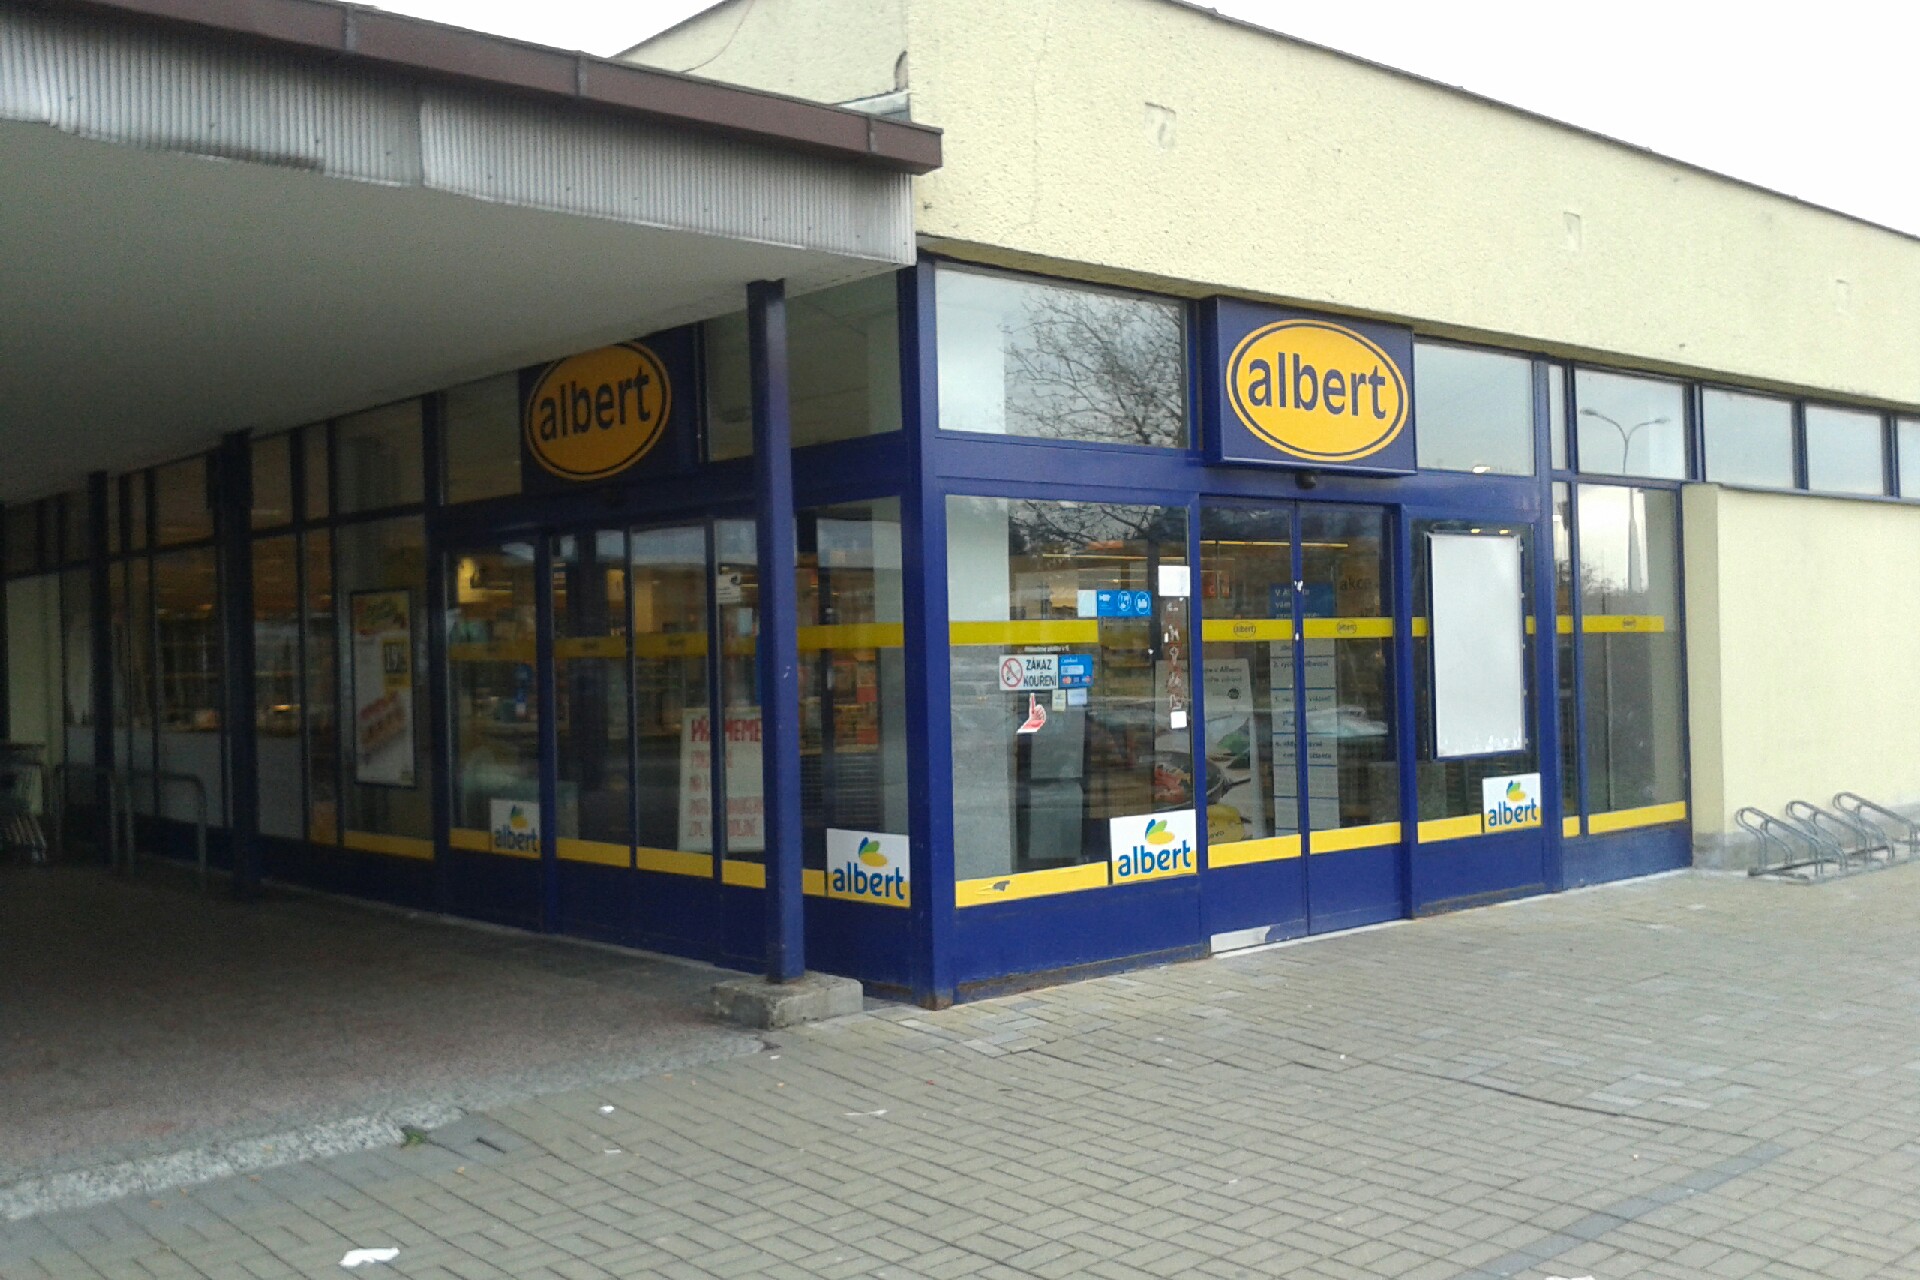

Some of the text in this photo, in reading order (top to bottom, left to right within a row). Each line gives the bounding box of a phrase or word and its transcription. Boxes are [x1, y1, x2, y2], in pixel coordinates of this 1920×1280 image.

[1248, 351, 1386, 420] albert
[540, 366, 650, 441] albert
[1023, 672, 1057, 687] KOUŘENÍ
[1026, 657, 1053, 671] ZÁKAZ
[1488, 797, 1538, 827] albert
[495, 824, 539, 853] albert
[1118, 839, 1192, 877] albert
[833, 861, 906, 900] albert
